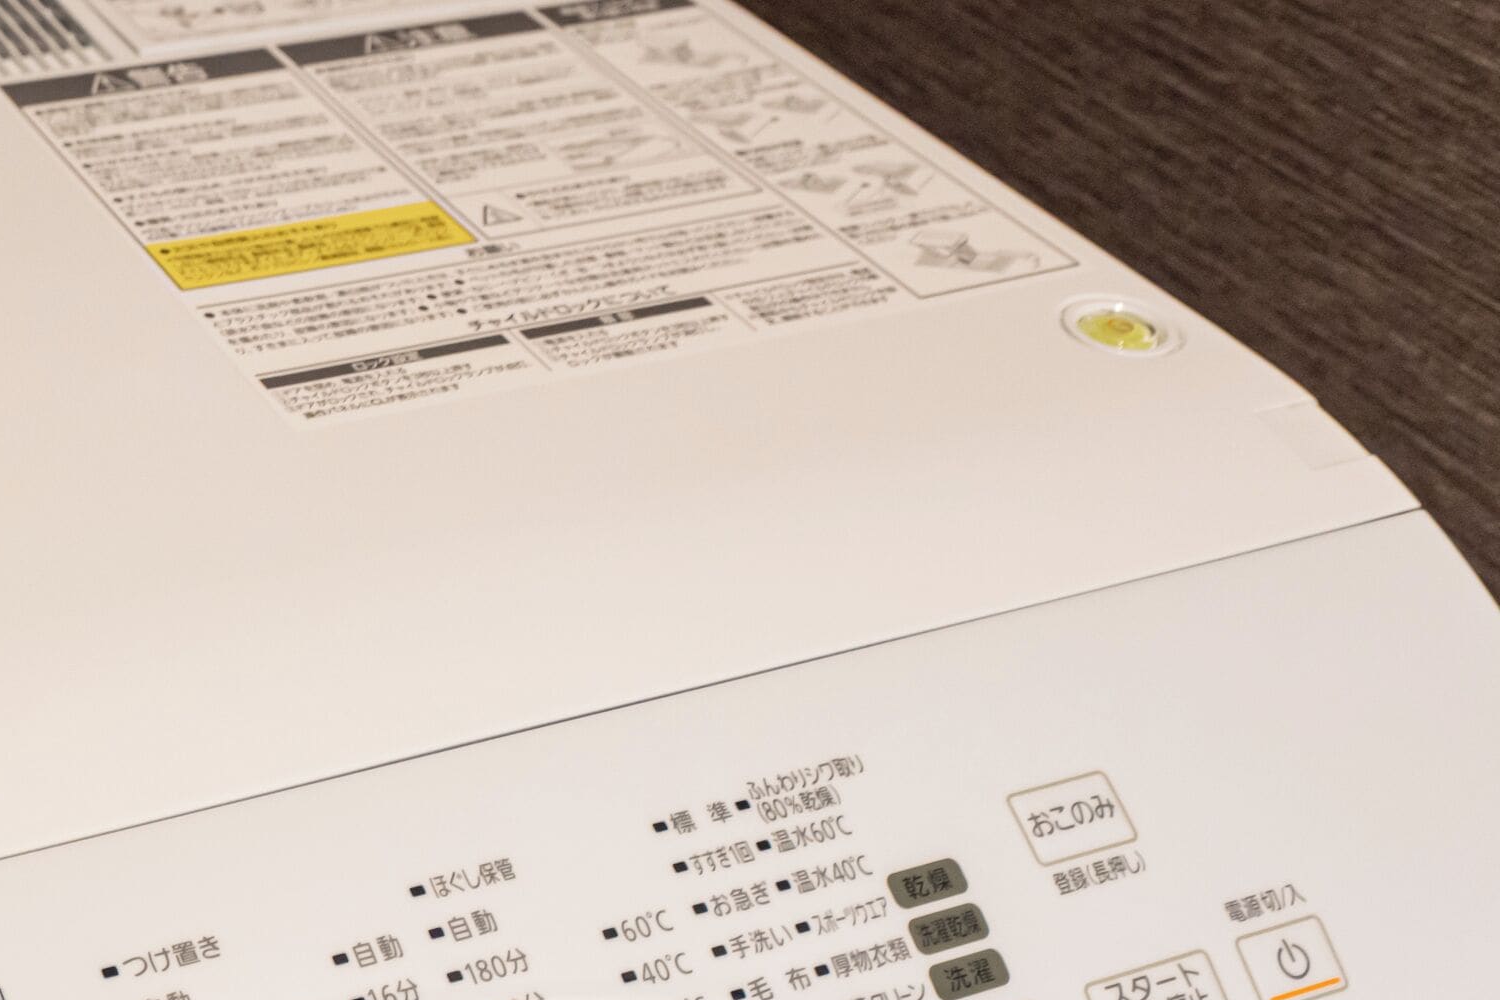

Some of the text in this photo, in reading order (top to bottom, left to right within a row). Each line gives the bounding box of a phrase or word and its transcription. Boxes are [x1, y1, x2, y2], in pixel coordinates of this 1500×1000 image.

[746, 753, 865, 801] ふんわりシワ取り
[670, 800, 734, 836] 標準
[757, 783, 842, 824] (80%乾燥)
[1027, 794, 1116, 838] おこのみ
[688, 840, 756, 876] すすぎ1回
[1052, 850, 1147, 896] 登録(長押し)
[429, 857, 517, 899] ほぐし保管
[902, 867, 955, 901] 乾燥
[710, 880, 772, 918] お急ぎ
[811, 896, 888, 936] スポーツウエア
[1223, 883, 1307, 923] 電源切/入
[446, 909, 499, 943] 自動
[621, 909, 675, 942] 60℃
[729, 925, 794, 960] 手洗い
[919, 910, 983, 947] 洗濯乾燥
[122, 935, 222, 978] つけ置き
[352, 934, 404, 969] 自動
[463, 948, 530, 985] 180分
[641, 951, 693, 985] 40℃
[831, 936, 914, 979] 厚物衣類
[944, 958, 997, 993] 洗濯
